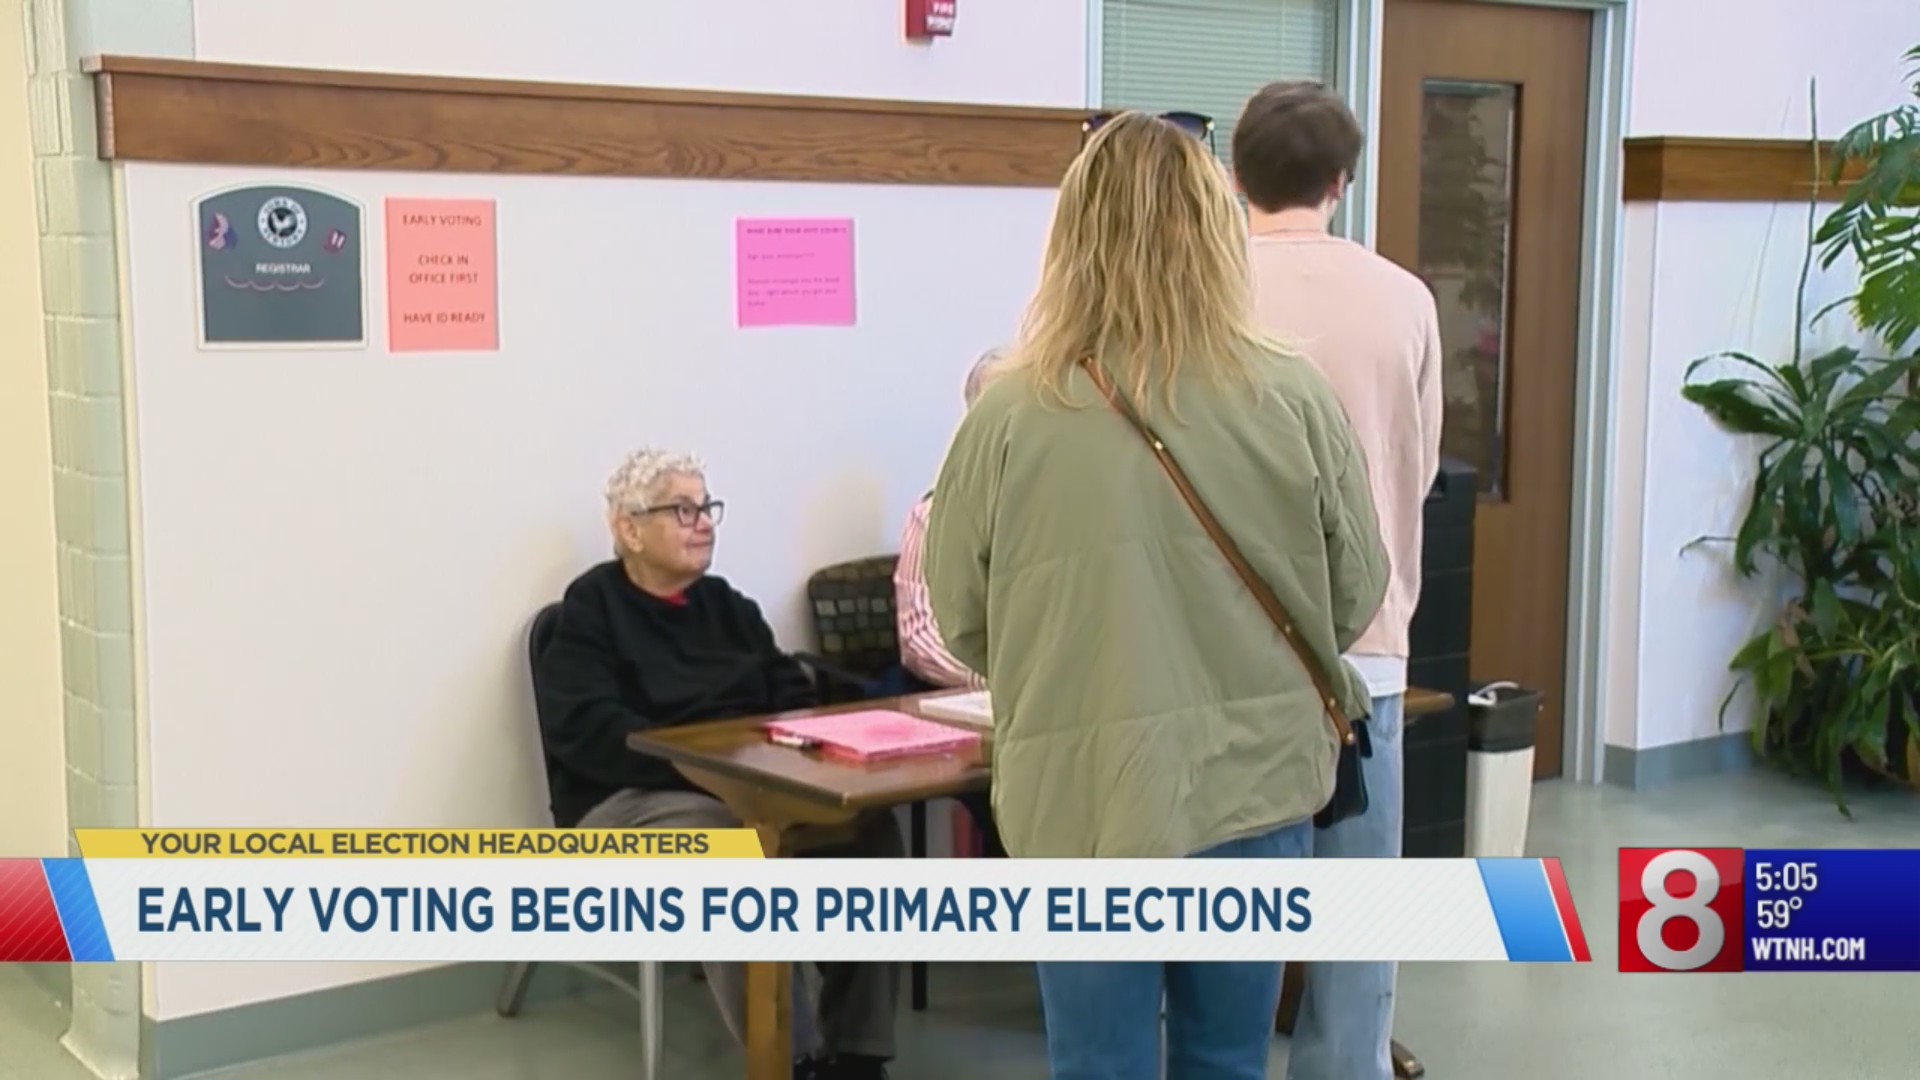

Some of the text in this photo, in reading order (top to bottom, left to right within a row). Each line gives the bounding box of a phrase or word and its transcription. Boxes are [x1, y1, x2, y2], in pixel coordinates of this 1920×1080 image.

[402, 214, 482, 226] EARLY VOTING
[418, 254, 469, 266] CHECK IN
[255, 262, 311, 274] REGISTRAR
[408, 272, 479, 284] OFFICE FIRST
[403, 311, 485, 323] HAVE ID READY
